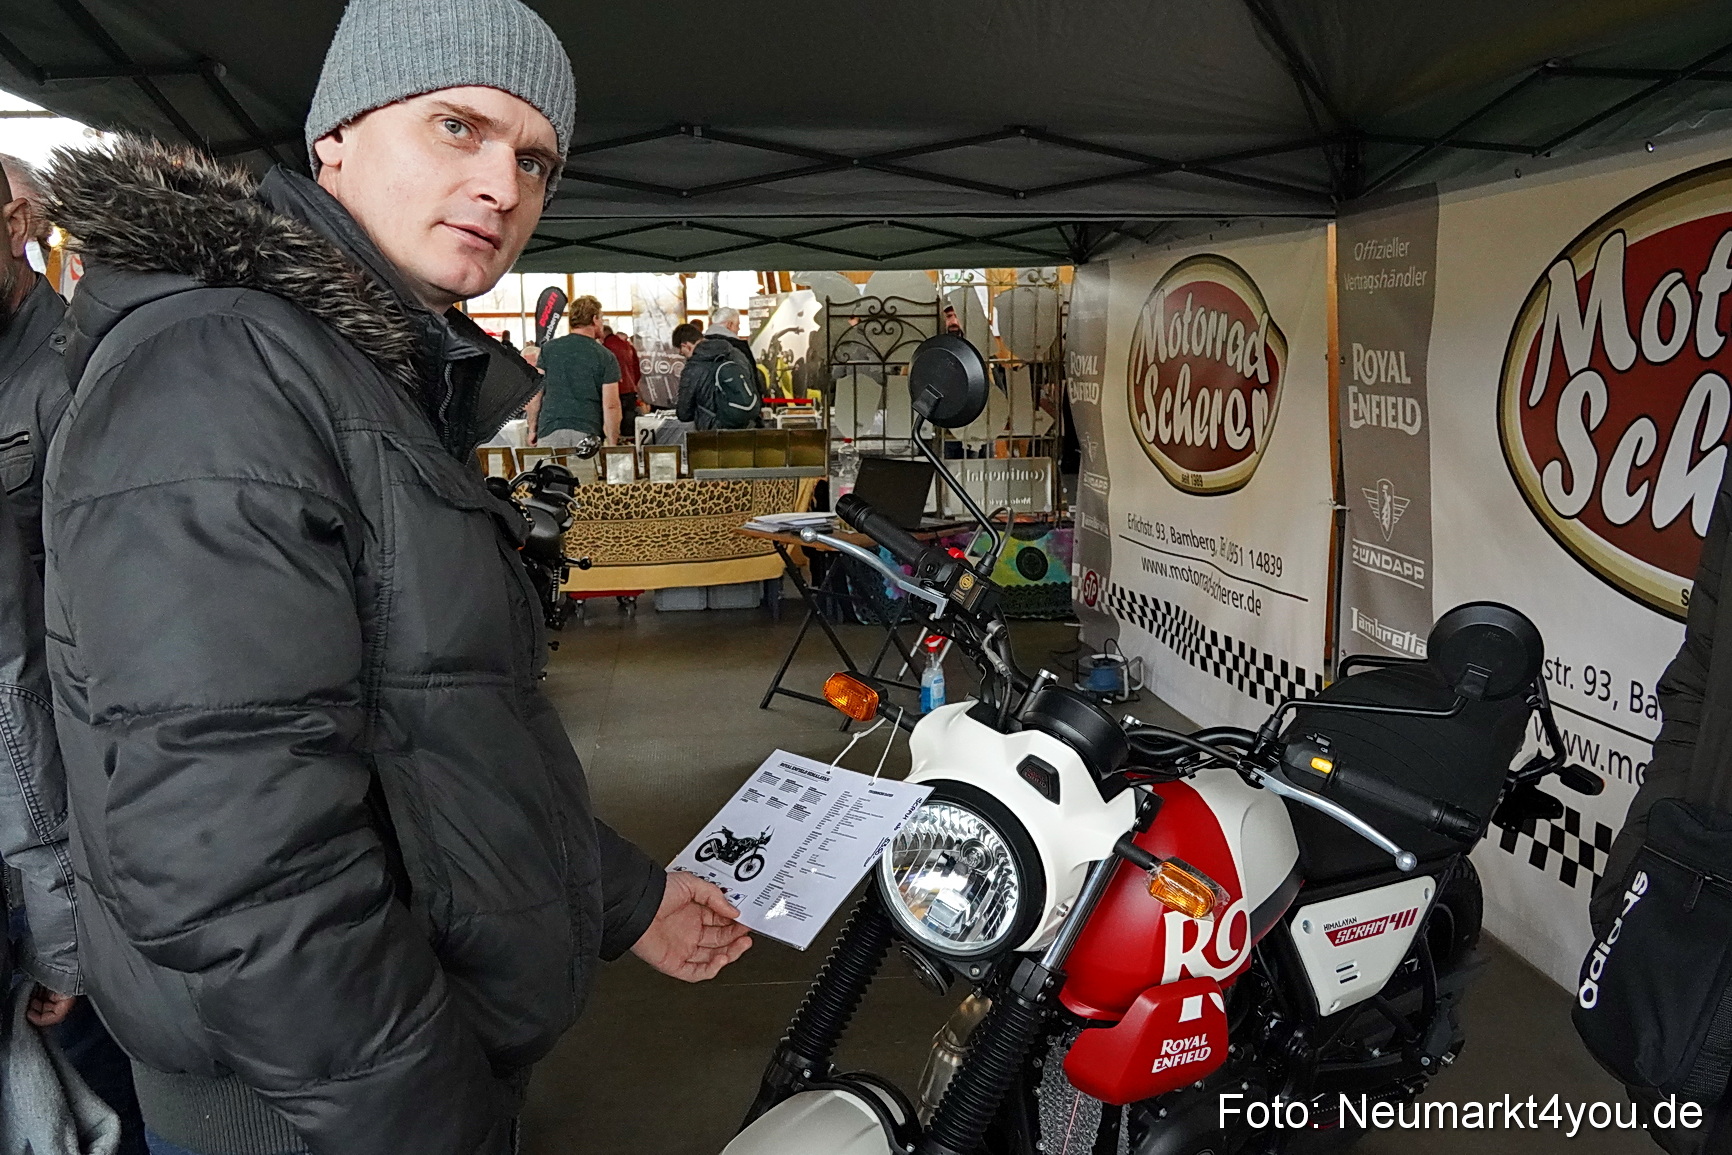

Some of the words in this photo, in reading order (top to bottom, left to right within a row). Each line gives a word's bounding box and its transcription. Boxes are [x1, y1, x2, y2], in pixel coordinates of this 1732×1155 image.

[1354, 236, 1411, 261] Offizieller
[1343, 265, 1428, 294] Vertragshändler
[539, 291, 559, 327] DUCATI
[1135, 288, 1270, 385] Motorrad
[1070, 352, 1098, 377] ROYAL
[1352, 342, 1411, 387] ROYAL
[1068, 378, 1100, 405] ENFIELD
[1140, 363, 1270, 453] Scherer
[1348, 386, 1422, 436] ENFIELD
[640, 429, 656, 446] 21
[1156, 522, 1169, 544] 93,
[1249, 549, 1283, 578] 14839
[1084, 572, 1097, 600] STP
[1350, 606, 1428, 658] Lambretta
[1583, 665, 1618, 711] 93,
[1323, 916, 1358, 931] HIMALAYAN
[1334, 919, 1387, 945] SCRAM
[1389, 907, 1419, 931] 411
[1151, 1046, 1212, 1074] ENFIELD
[1160, 1033, 1208, 1056] ROYAL
